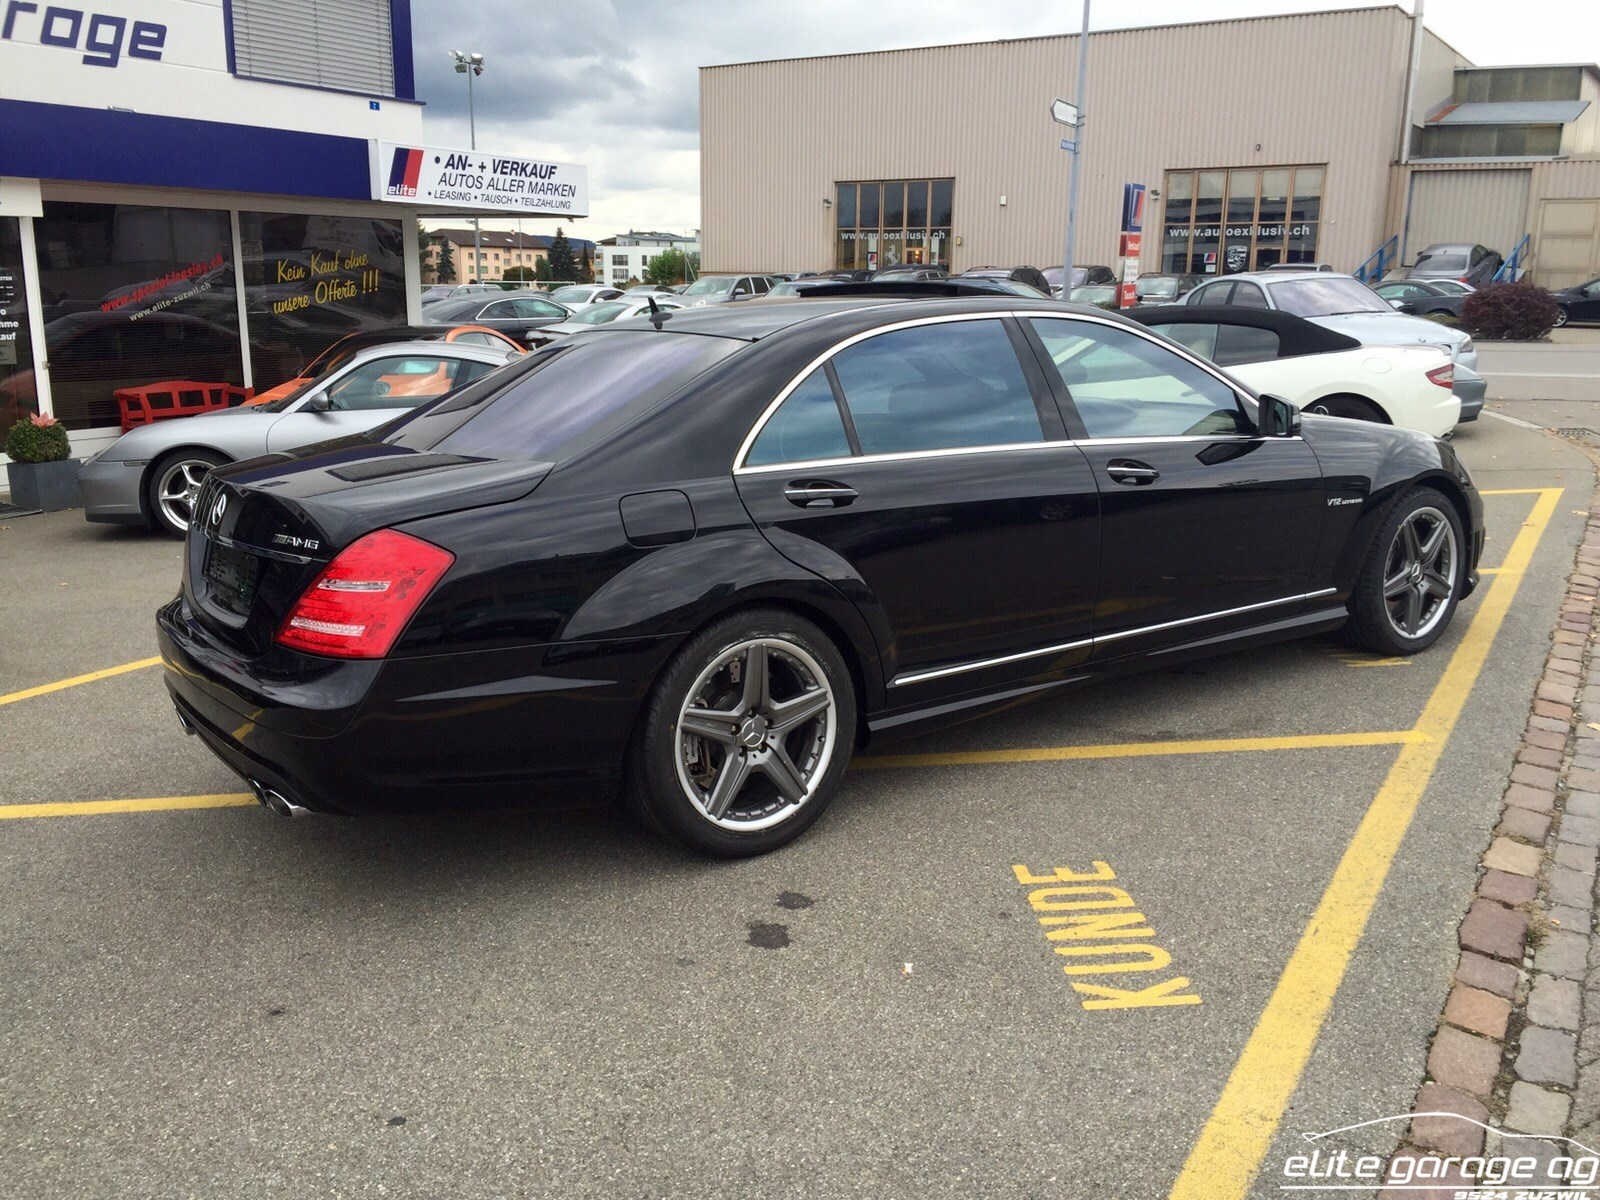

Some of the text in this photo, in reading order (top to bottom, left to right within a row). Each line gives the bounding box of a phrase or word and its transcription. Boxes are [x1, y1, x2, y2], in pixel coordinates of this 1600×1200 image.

[445, 153, 473, 171] AN-
[492, 159, 558, 180] VERKAUF
[388, 183, 417, 196] elite
[438, 172, 577, 198] AUTOS ALLER MARKEN
[434, 190, 571, 209] LEASING TAUSCH TEILZAHLUNG
[277, 249, 369, 283] Kein Kauf ohne
[273, 294, 311, 315] unsere
[315, 279, 358, 304] Offerte
[1011, 860, 1204, 1011] KUNDE
